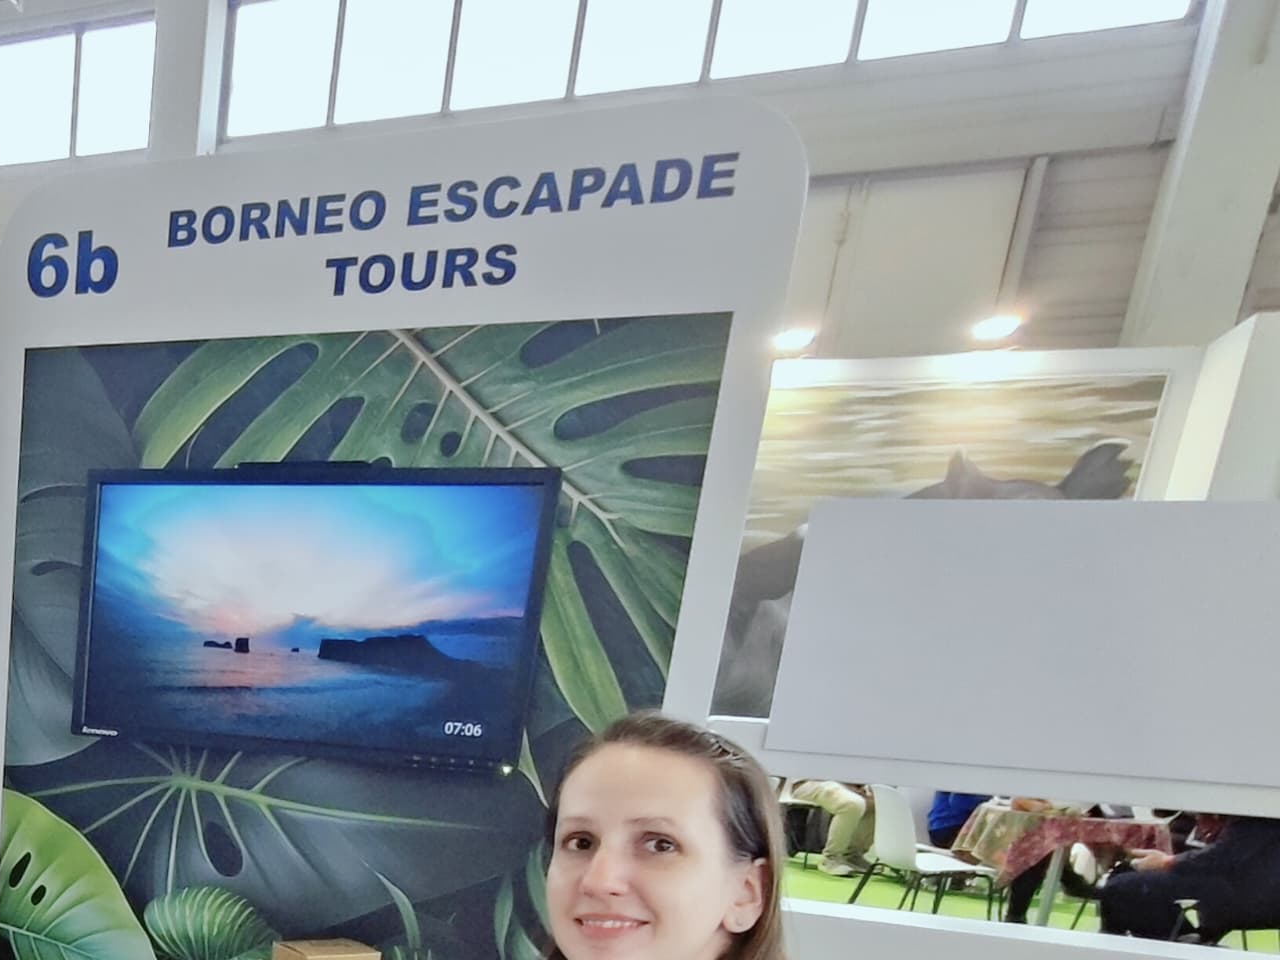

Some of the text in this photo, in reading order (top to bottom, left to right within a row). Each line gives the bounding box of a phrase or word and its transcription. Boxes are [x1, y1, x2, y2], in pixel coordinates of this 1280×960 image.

[167, 151, 741, 249] BORNEO ESCAPADE
[26, 229, 120, 299] 6b
[324, 243, 518, 297] TOURS
[444, 721, 483, 737] 07:06
